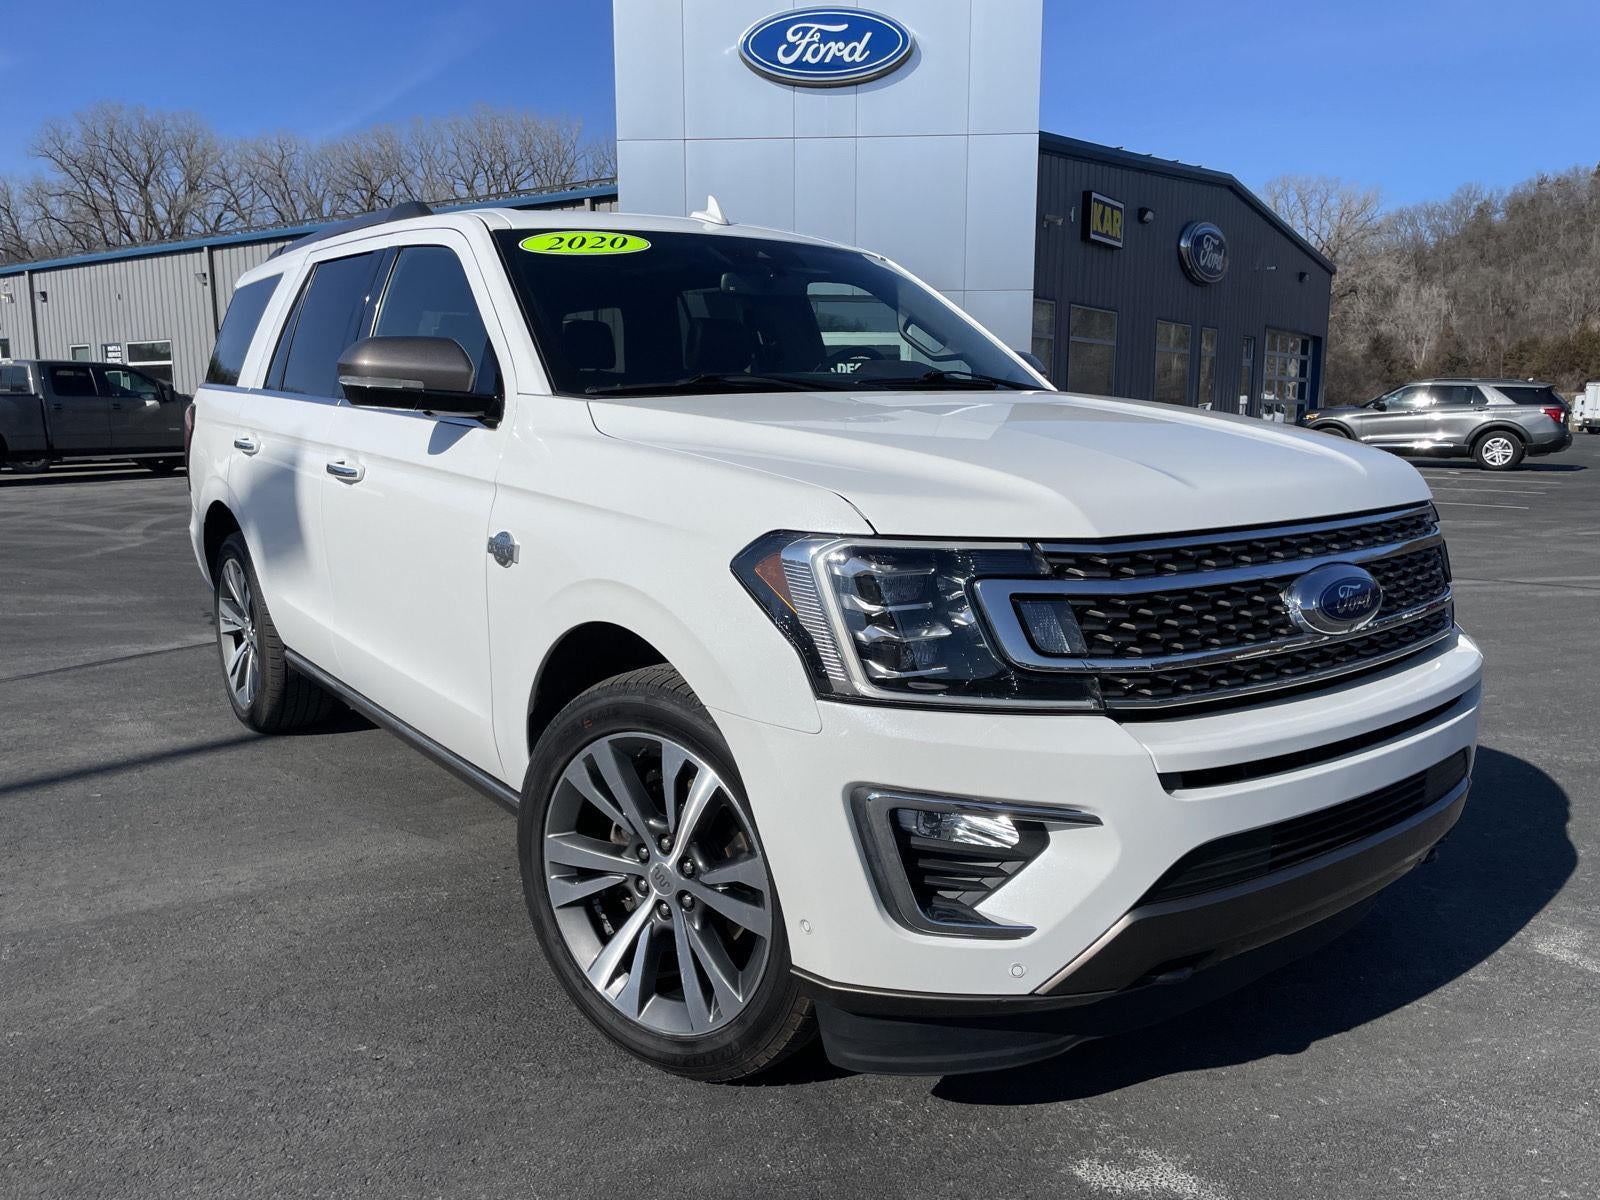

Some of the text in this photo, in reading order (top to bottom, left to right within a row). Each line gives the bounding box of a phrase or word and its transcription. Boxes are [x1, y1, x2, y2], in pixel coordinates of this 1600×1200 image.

[777, 23, 872, 65] Ford
[1093, 202, 1122, 239] KAR
[545, 236, 628, 250] 2020
[1200, 234, 1225, 271] Ford
[1336, 583, 1372, 614] Ford
